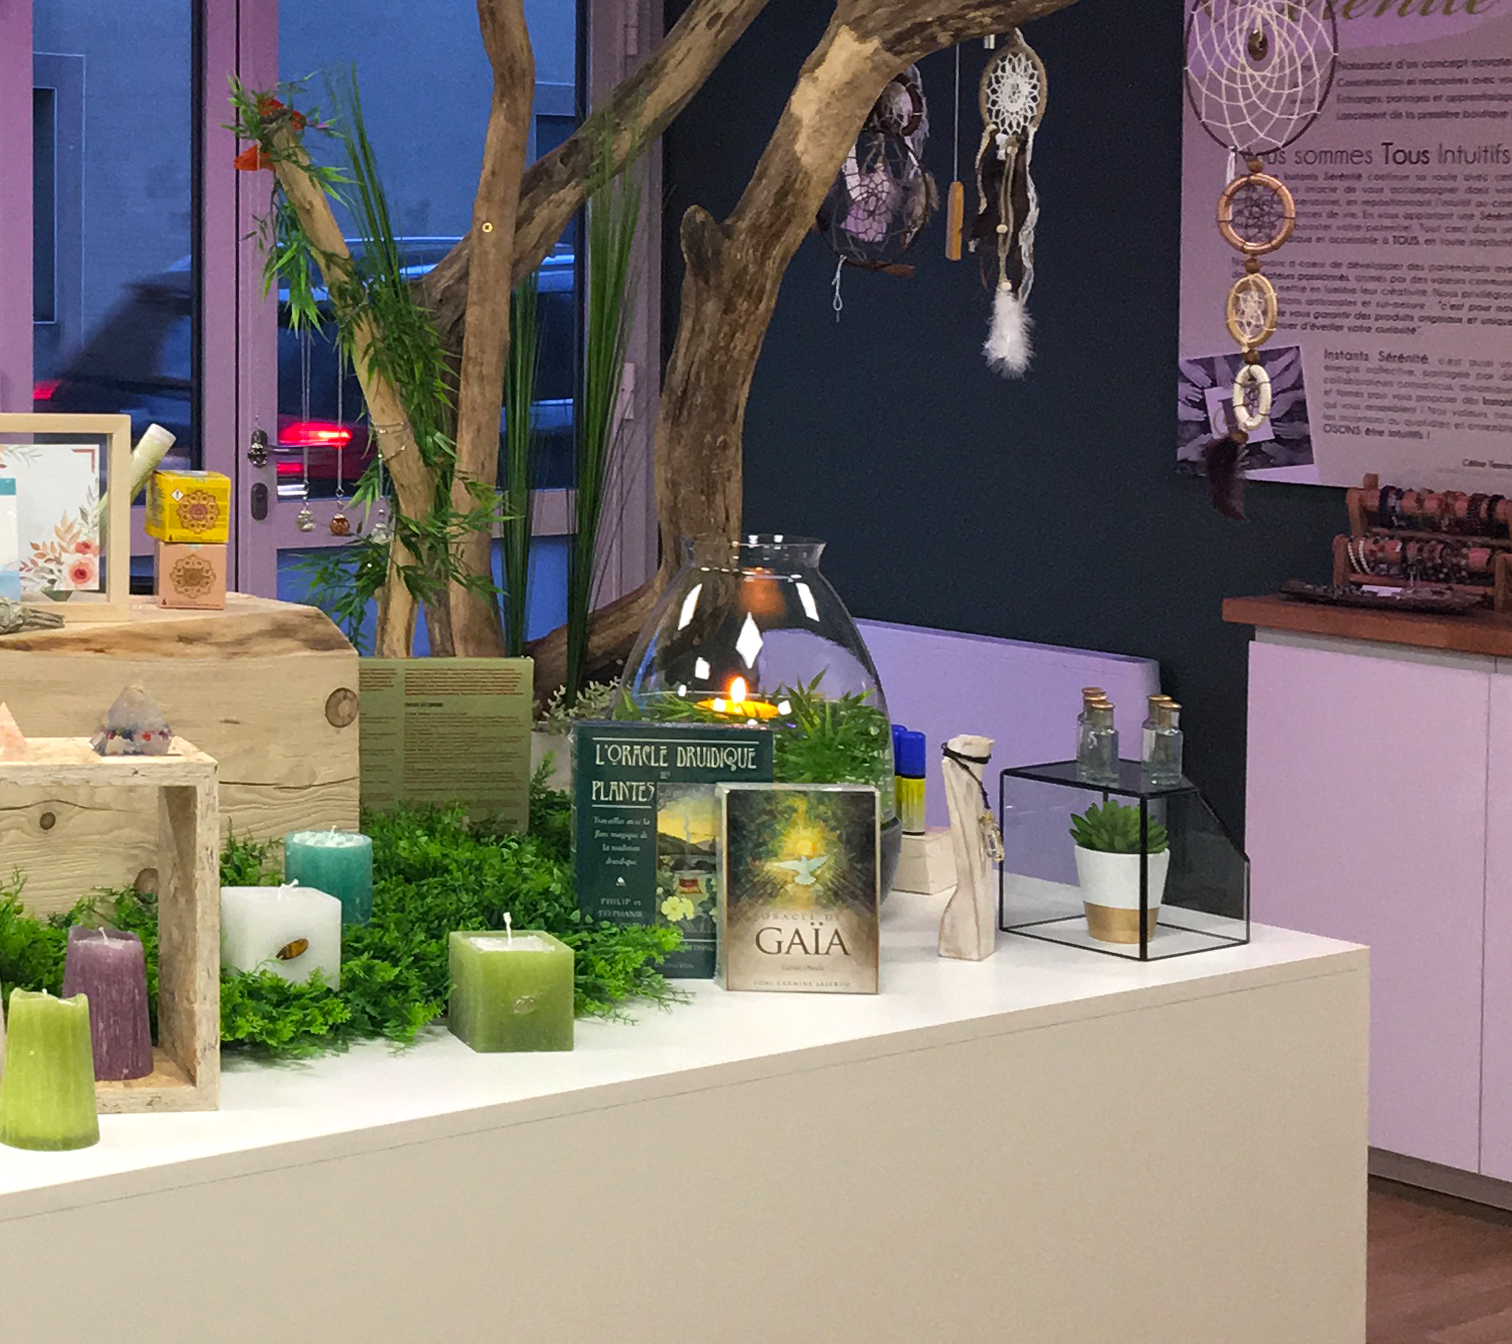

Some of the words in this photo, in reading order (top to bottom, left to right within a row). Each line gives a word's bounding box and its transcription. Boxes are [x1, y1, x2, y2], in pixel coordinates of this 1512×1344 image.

[1234, 143, 1285, 165] Nus
[1294, 149, 1373, 165] sommes
[1381, 141, 1431, 165] Tous
[1438, 141, 1511, 165] Intuitifs
[1324, 349, 1370, 362] Instants
[595, 744, 669, 768] L'ORACLE
[676, 746, 758, 772] DRUIDIQUE
[591, 781, 656, 802] PLANTES
[600, 898, 632, 906] PHILIP
[755, 921, 851, 956] GAÏA
